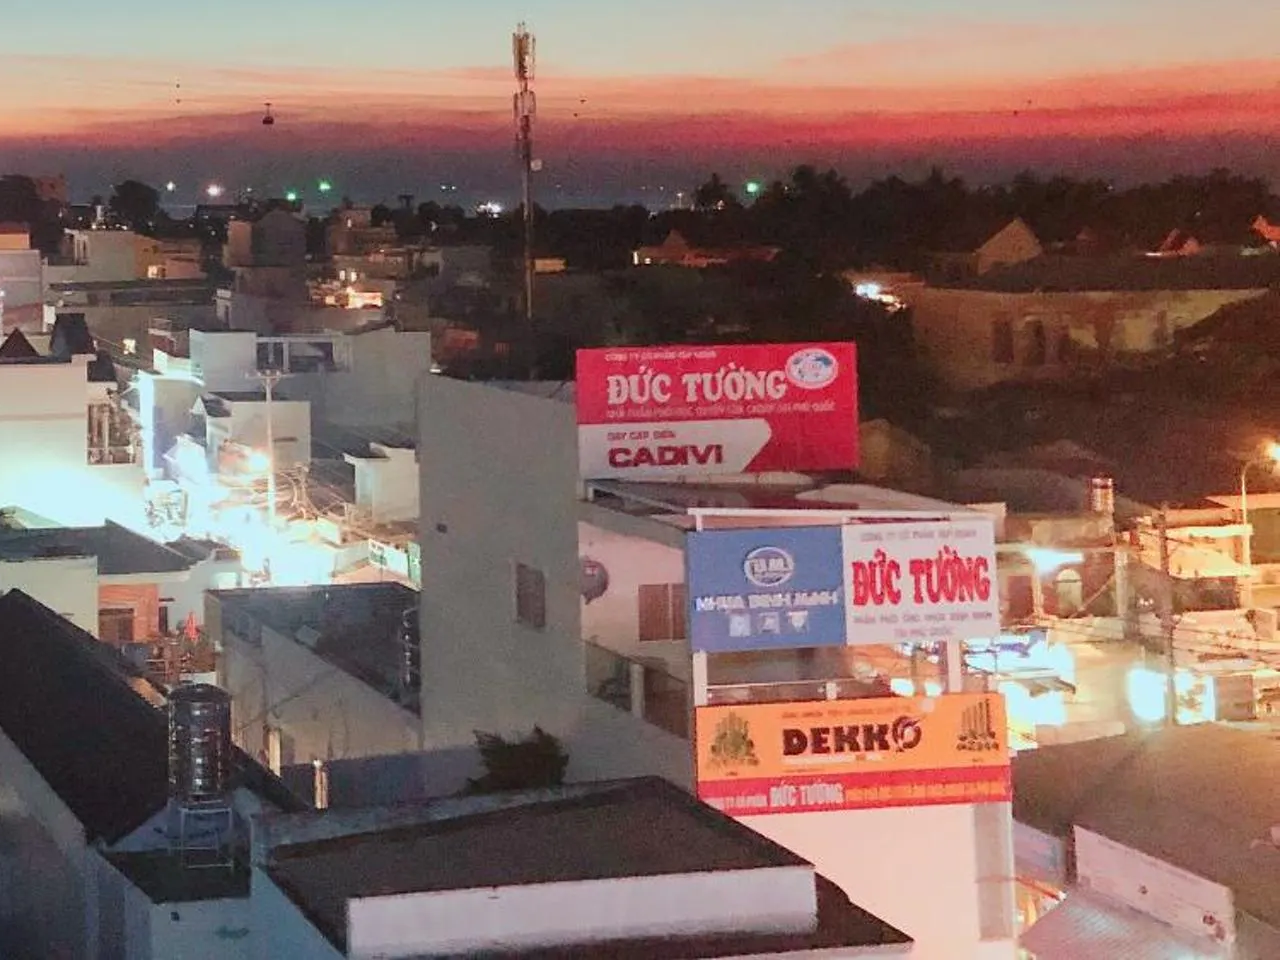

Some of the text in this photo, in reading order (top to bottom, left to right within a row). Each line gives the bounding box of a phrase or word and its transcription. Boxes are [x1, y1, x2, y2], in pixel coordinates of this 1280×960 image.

[607, 362, 788, 405] ĐỨC TƯỜNG
[608, 444, 723, 468] CADIVI
[852, 545, 991, 606] ĐỨC TƯỜNG
[782, 716, 925, 756] DEKKO
